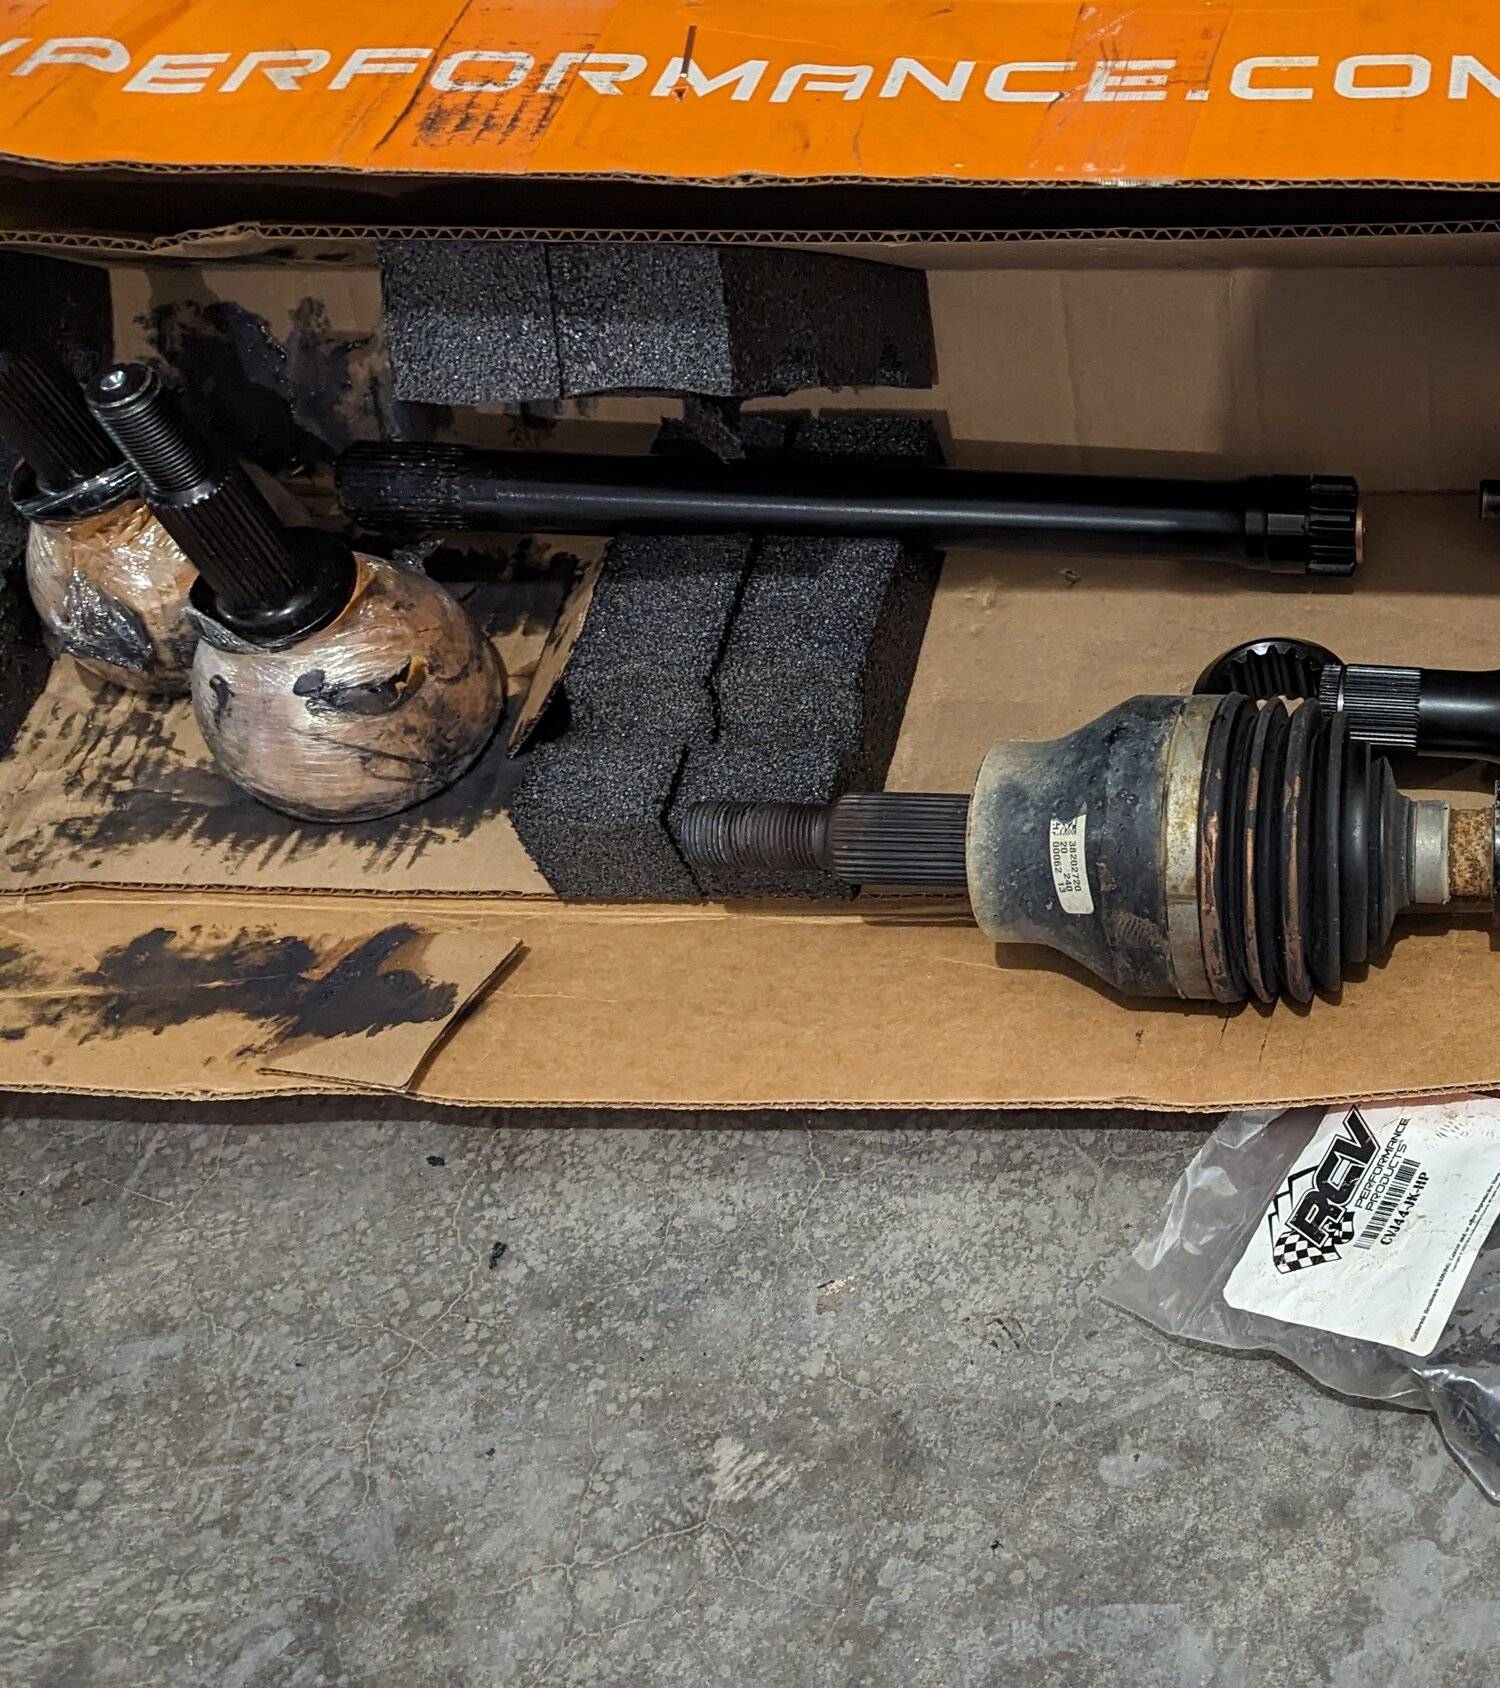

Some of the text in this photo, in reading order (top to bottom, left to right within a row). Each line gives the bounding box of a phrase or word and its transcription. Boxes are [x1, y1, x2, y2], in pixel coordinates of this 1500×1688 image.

[1068, 841, 1082, 892] 38202720
[1285, 1105, 1381, 1248] RCV
[1354, 1117, 1409, 1209] PERFORMANCE
